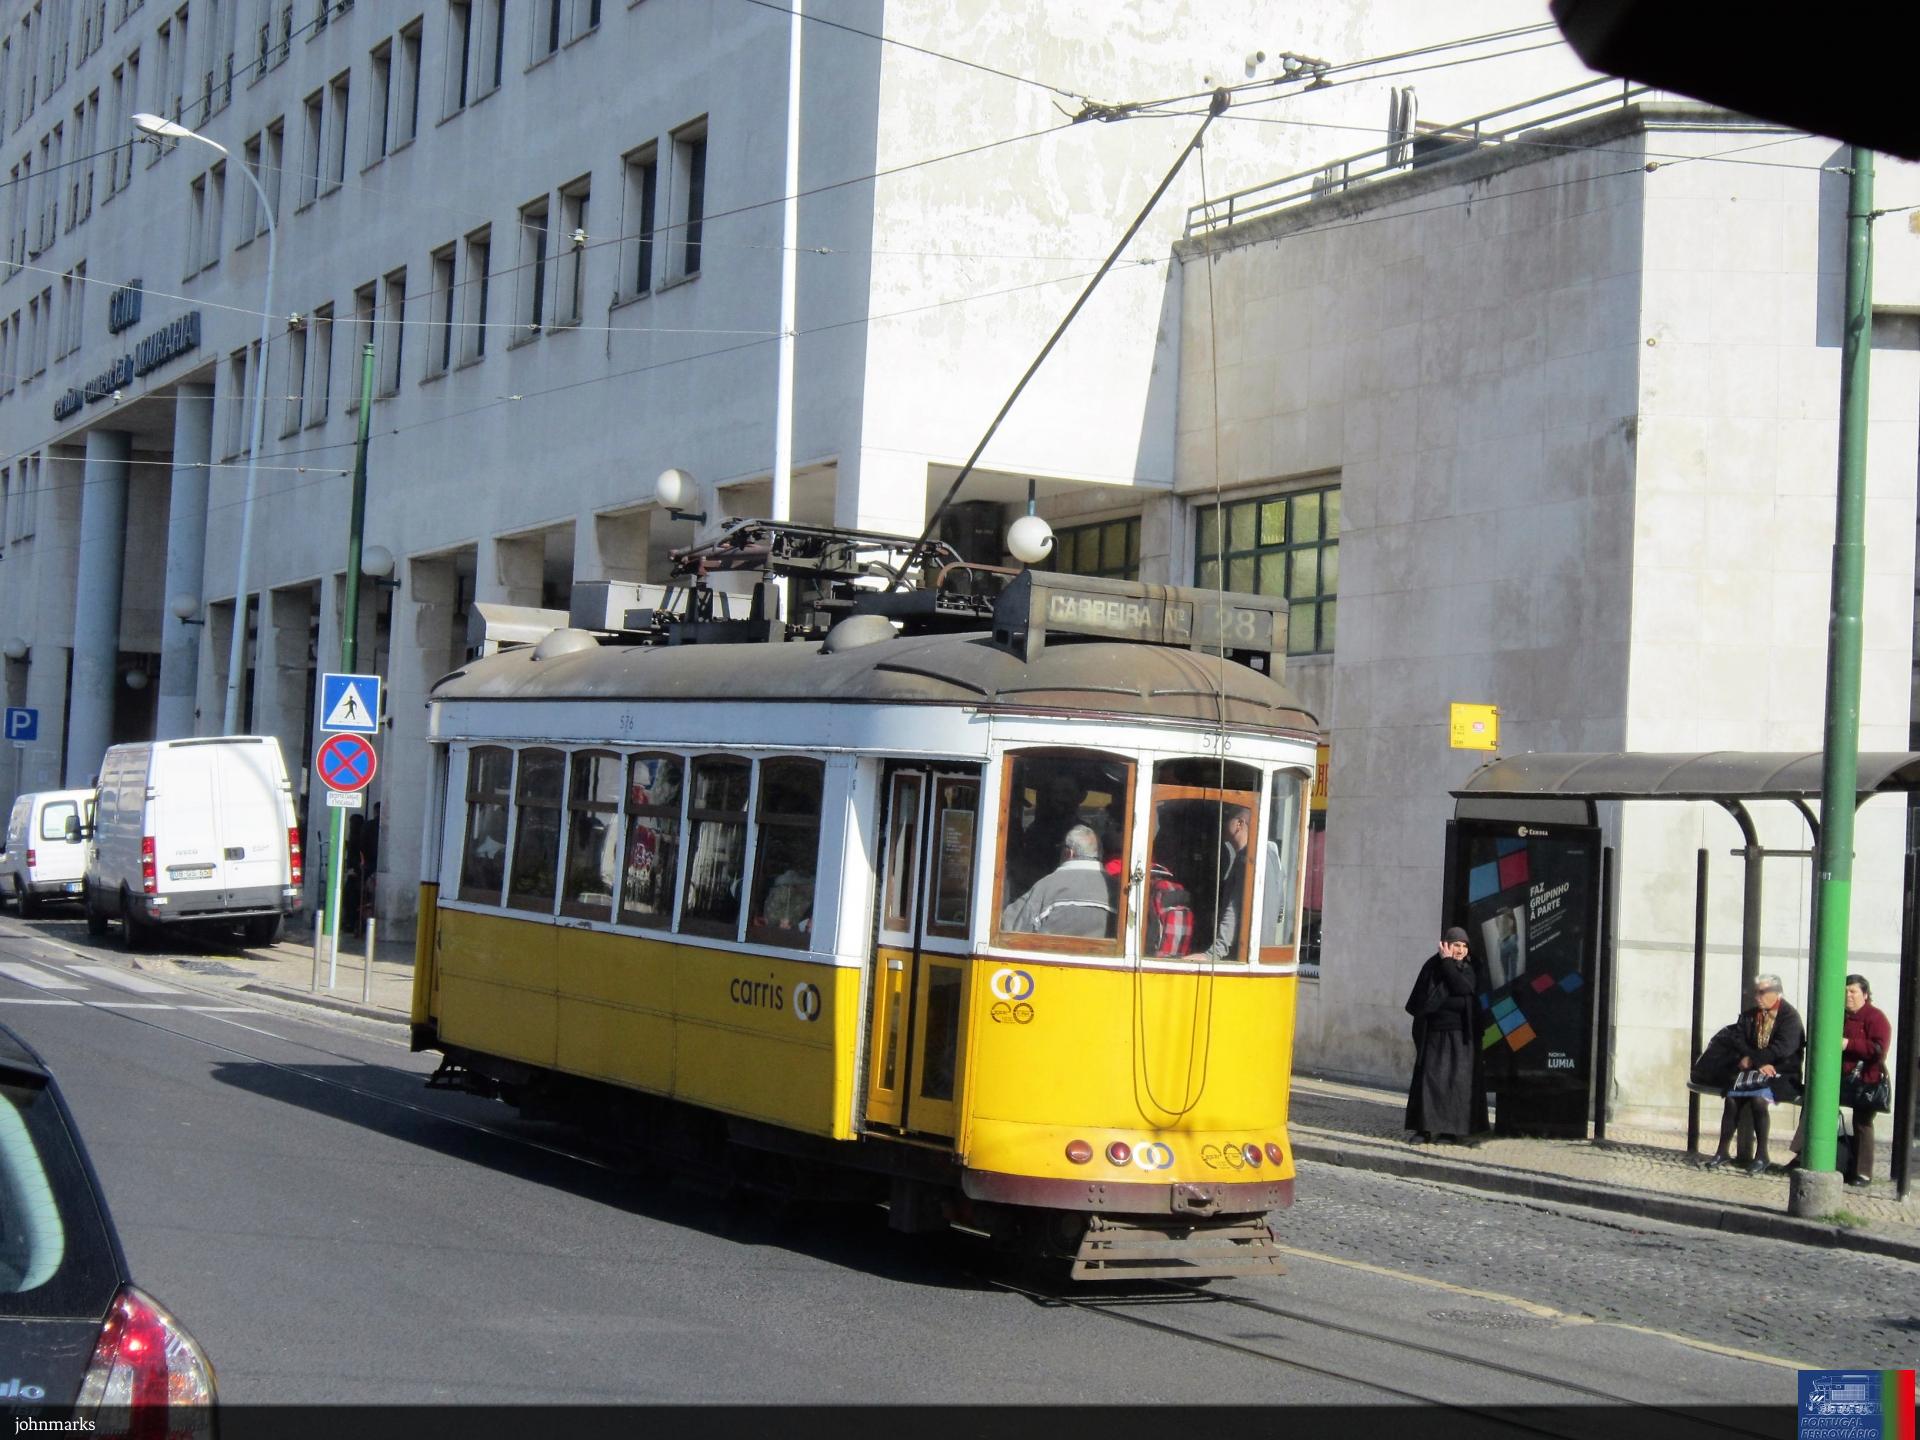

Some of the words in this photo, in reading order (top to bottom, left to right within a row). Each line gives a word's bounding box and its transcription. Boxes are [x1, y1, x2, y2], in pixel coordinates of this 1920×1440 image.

[12, 710, 31, 737] P
[1202, 732, 1232, 751] 576
[1529, 881, 1570, 909] GRUPINHO
[1530, 881, 1545, 897] FAZ
[1537, 897, 1561, 918] PARTE
[730, 972, 784, 1011] carris
[1547, 1058, 1575, 1069] LUMIA
